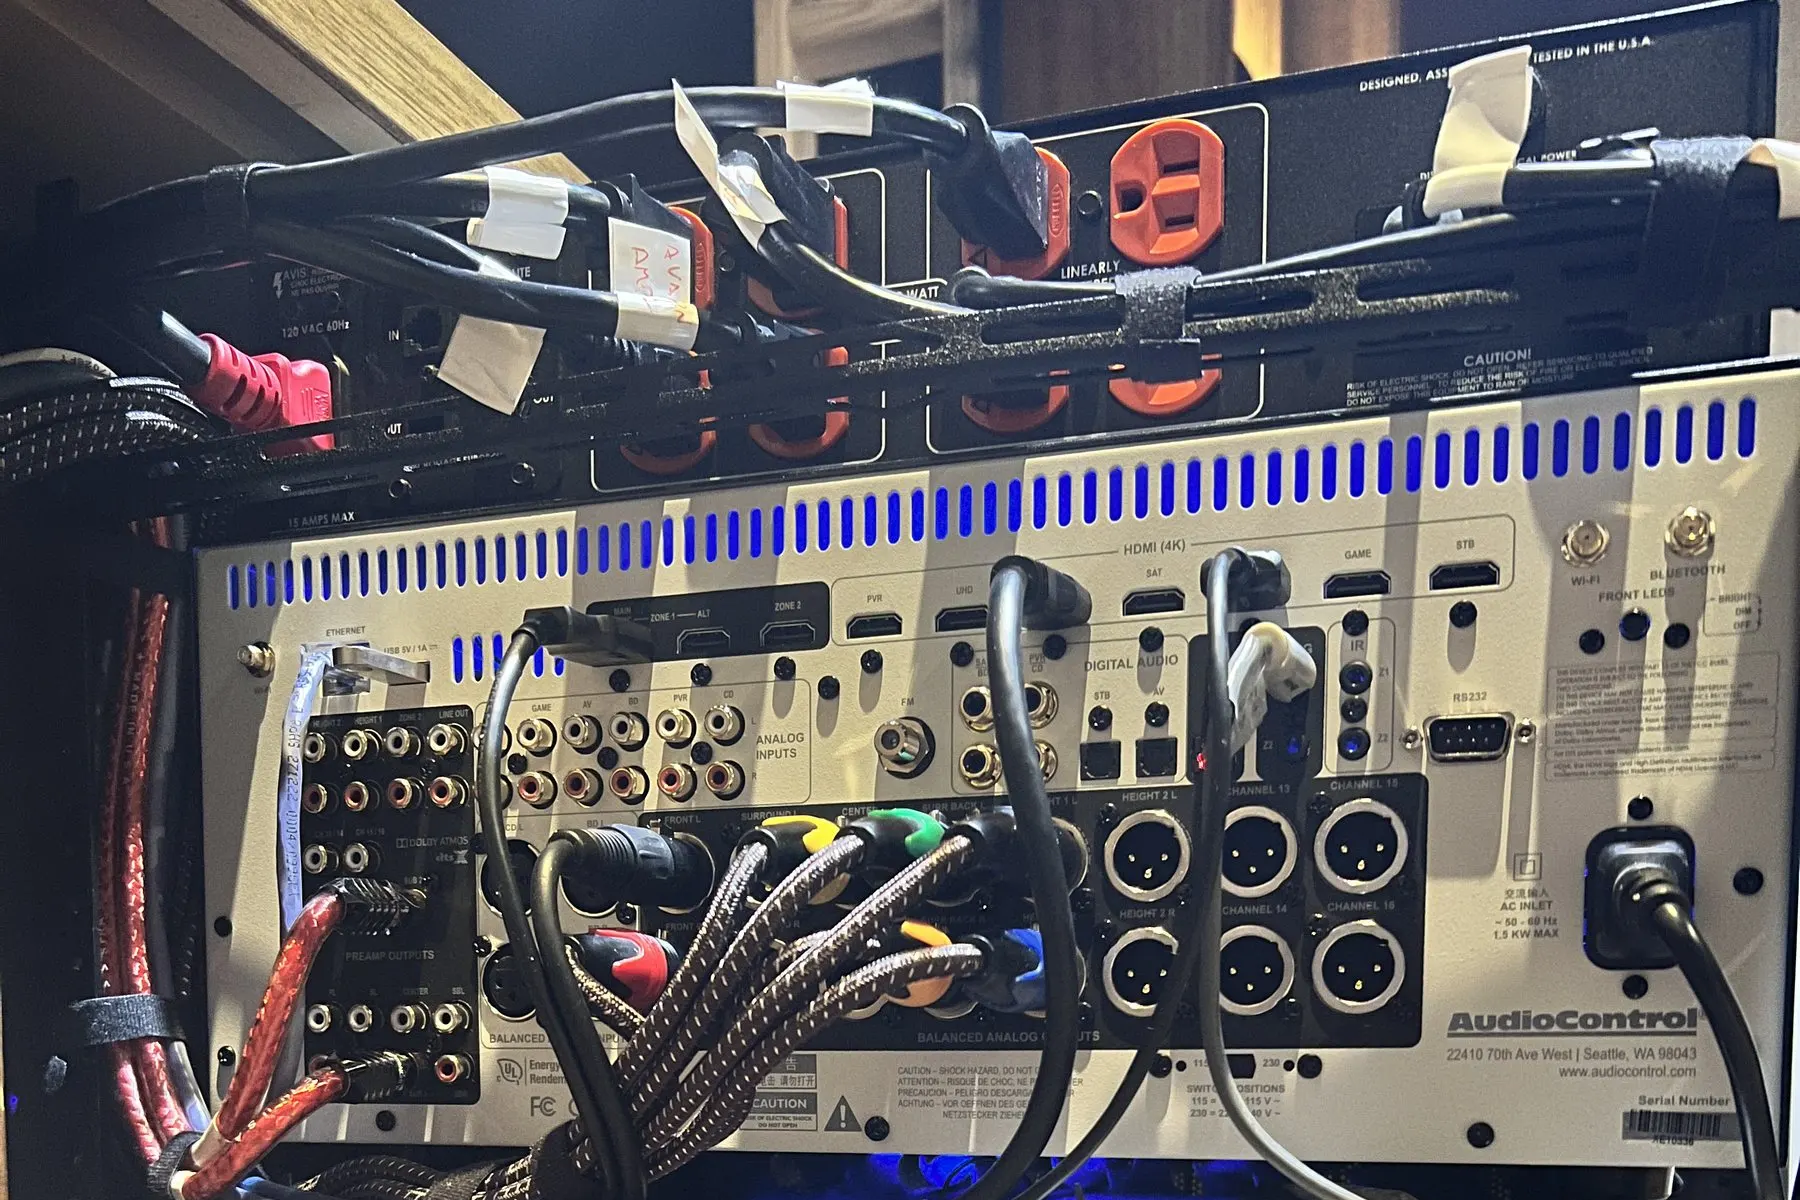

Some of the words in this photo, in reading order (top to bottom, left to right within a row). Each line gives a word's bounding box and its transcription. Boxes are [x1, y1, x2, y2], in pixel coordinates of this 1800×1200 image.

[1533, 48, 1573, 64] TESTED
[1577, 46, 1590, 57] IN
[1594, 43, 1615, 55] THE
[1359, 71, 1421, 92] DESIGNED,
[1061, 260, 1120, 279] LINEARLY
[906, 286, 939, 300] WATT
[282, 326, 299, 339] 120
[301, 322, 323, 335] VAC
[326, 319, 350, 331] 60Hz
[388, 329, 399, 341] IN
[1463, 348, 1532, 367] CAUTION!
[1347, 382, 1365, 391] RISK
[1380, 375, 1419, 387] ELECTRIC
[1467, 367, 1484, 376] NOT
[1347, 389, 1380, 398] SERVICE
[1450, 376, 1484, 387] REDUCE
[1486, 373, 1502, 382] THE
[1504, 371, 1523, 380] RISK
[1347, 398, 1358, 407] DO
[1359, 396, 1376, 405] NOT
[1378, 393, 1411, 403] EXPOSE
[1432, 384, 1480, 397] EQUIPMENT
[1495, 380, 1515, 390] RAIN
[301, 514, 329, 527] AMPS
[331, 511, 355, 524] MAX
[1123, 541, 1154, 556] HDMI
[1155, 538, 1186, 553] (4K)
[1456, 539, 1475, 549] STB
[1344, 549, 1372, 559] GAME
[1146, 567, 1162, 578] SAT
[1650, 565, 1726, 581] BLUETOOTH
[1571, 576, 1600, 586] WI-FI
[956, 585, 973, 595] UHD
[1598, 589, 1638, 602] FRONT
[1643, 587, 1675, 599] LEDS
[867, 594, 882, 604] PVR
[1718, 593, 1752, 604] BRIGHT
[775, 602, 795, 611] ZONE
[650, 613, 670, 622] ZONE
[698, 609, 711, 619] ALT
[326, 626, 366, 637] ETHERNET
[418, 644, 429, 653] 1A
[1350, 639, 1365, 652] IR
[1084, 658, 1134, 672] DIGITAL
[1137, 653, 1179, 668] AUDIO
[1379, 666, 1389, 677] Z1
[723, 690, 734, 699] CD
[1094, 691, 1110, 700] STB
[1153, 687, 1165, 697] AV
[1453, 691, 1487, 703] RS232
[628, 697, 639, 706] BD
[673, 693, 688, 703] PVR
[901, 697, 915, 706] FM
[532, 703, 552, 712] GAME
[583, 700, 592, 709] AV
[439, 710, 454, 719] LINE
[454, 709, 468, 718] OUT
[354, 716, 378, 725] HEIGHT
[756, 731, 804, 746] ANALOG
[756, 746, 797, 760] INPUTS
[1277, 783, 1291, 794] 13
[1330, 778, 1382, 791] CHANNEL
[1122, 791, 1156, 802] HEIGHT
[922, 803, 943, 812] SURR
[947, 801, 978, 812] BACK
[586, 820, 598, 828] BD
[664, 815, 693, 826] FRONT
[505, 824, 516, 832] CD
[409, 837, 437, 847] DOLBY
[439, 836, 468, 846] ATMOS
[1222, 905, 1269, 916] CHANNEL
[1273, 904, 1287, 914] 14
[1328, 902, 1378, 913] CHANNEL
[1381, 901, 1395, 911] 16
[1500, 901, 1516, 911] AC
[1520, 900, 1553, 911] INLET
[1119, 909, 1157, 919] HEIGHT
[1494, 929, 1508, 940] 1.5
[1511, 929, 1531, 939] KW
[1534, 928, 1559, 938] MAX
[346, 951, 385, 961] PREAMP
[388, 949, 435, 961] OUTPUTS
[1447, 1008, 1697, 1033] AudioControl
[489, 1033, 545, 1044] BALANCED
[918, 1031, 983, 1043] BALANCED
[986, 1031, 1037, 1042] ANALOG
[1447, 1048, 1483, 1061] 22410
[1486, 1048, 1512, 1061] 70th
[1515, 1048, 1538, 1061] Ave
[1540, 1048, 1573, 1061] West
[1583, 1047, 1630, 1062] Seattle,
[1634, 1048, 1657, 1061] WA
[1658, 1048, 1697, 1061] 98043
[529, 1059, 560, 1071] Energy
[1263, 1058, 1280, 1067] 230
[897, 1066, 931, 1075] CAUTION
[939, 1066, 966, 1075] SHOCK
[1003, 1066, 1014, 1074] DO
[1016, 1066, 1032, 1075] NOT
[1559, 1064, 1697, 1079] www.audiocontrol.com
[897, 1077, 940, 1086] ATTENTION
[947, 1077, 976, 1086] RISQUE
[978, 1077, 989, 1086] DE
[955, 1088, 988, 1097] PELIGRO
[752, 1098, 807, 1109] CAUTION
[897, 1099, 935, 1108] ACHTUNG
[943, 1099, 959, 1108] VOR
[961, 1099, 997, 1108] OEFFNEN
[1638, 1095, 1675, 1106] Serial
[1678, 1095, 1731, 1107] Number
[943, 1110, 998, 1119] NETZSTECKER
